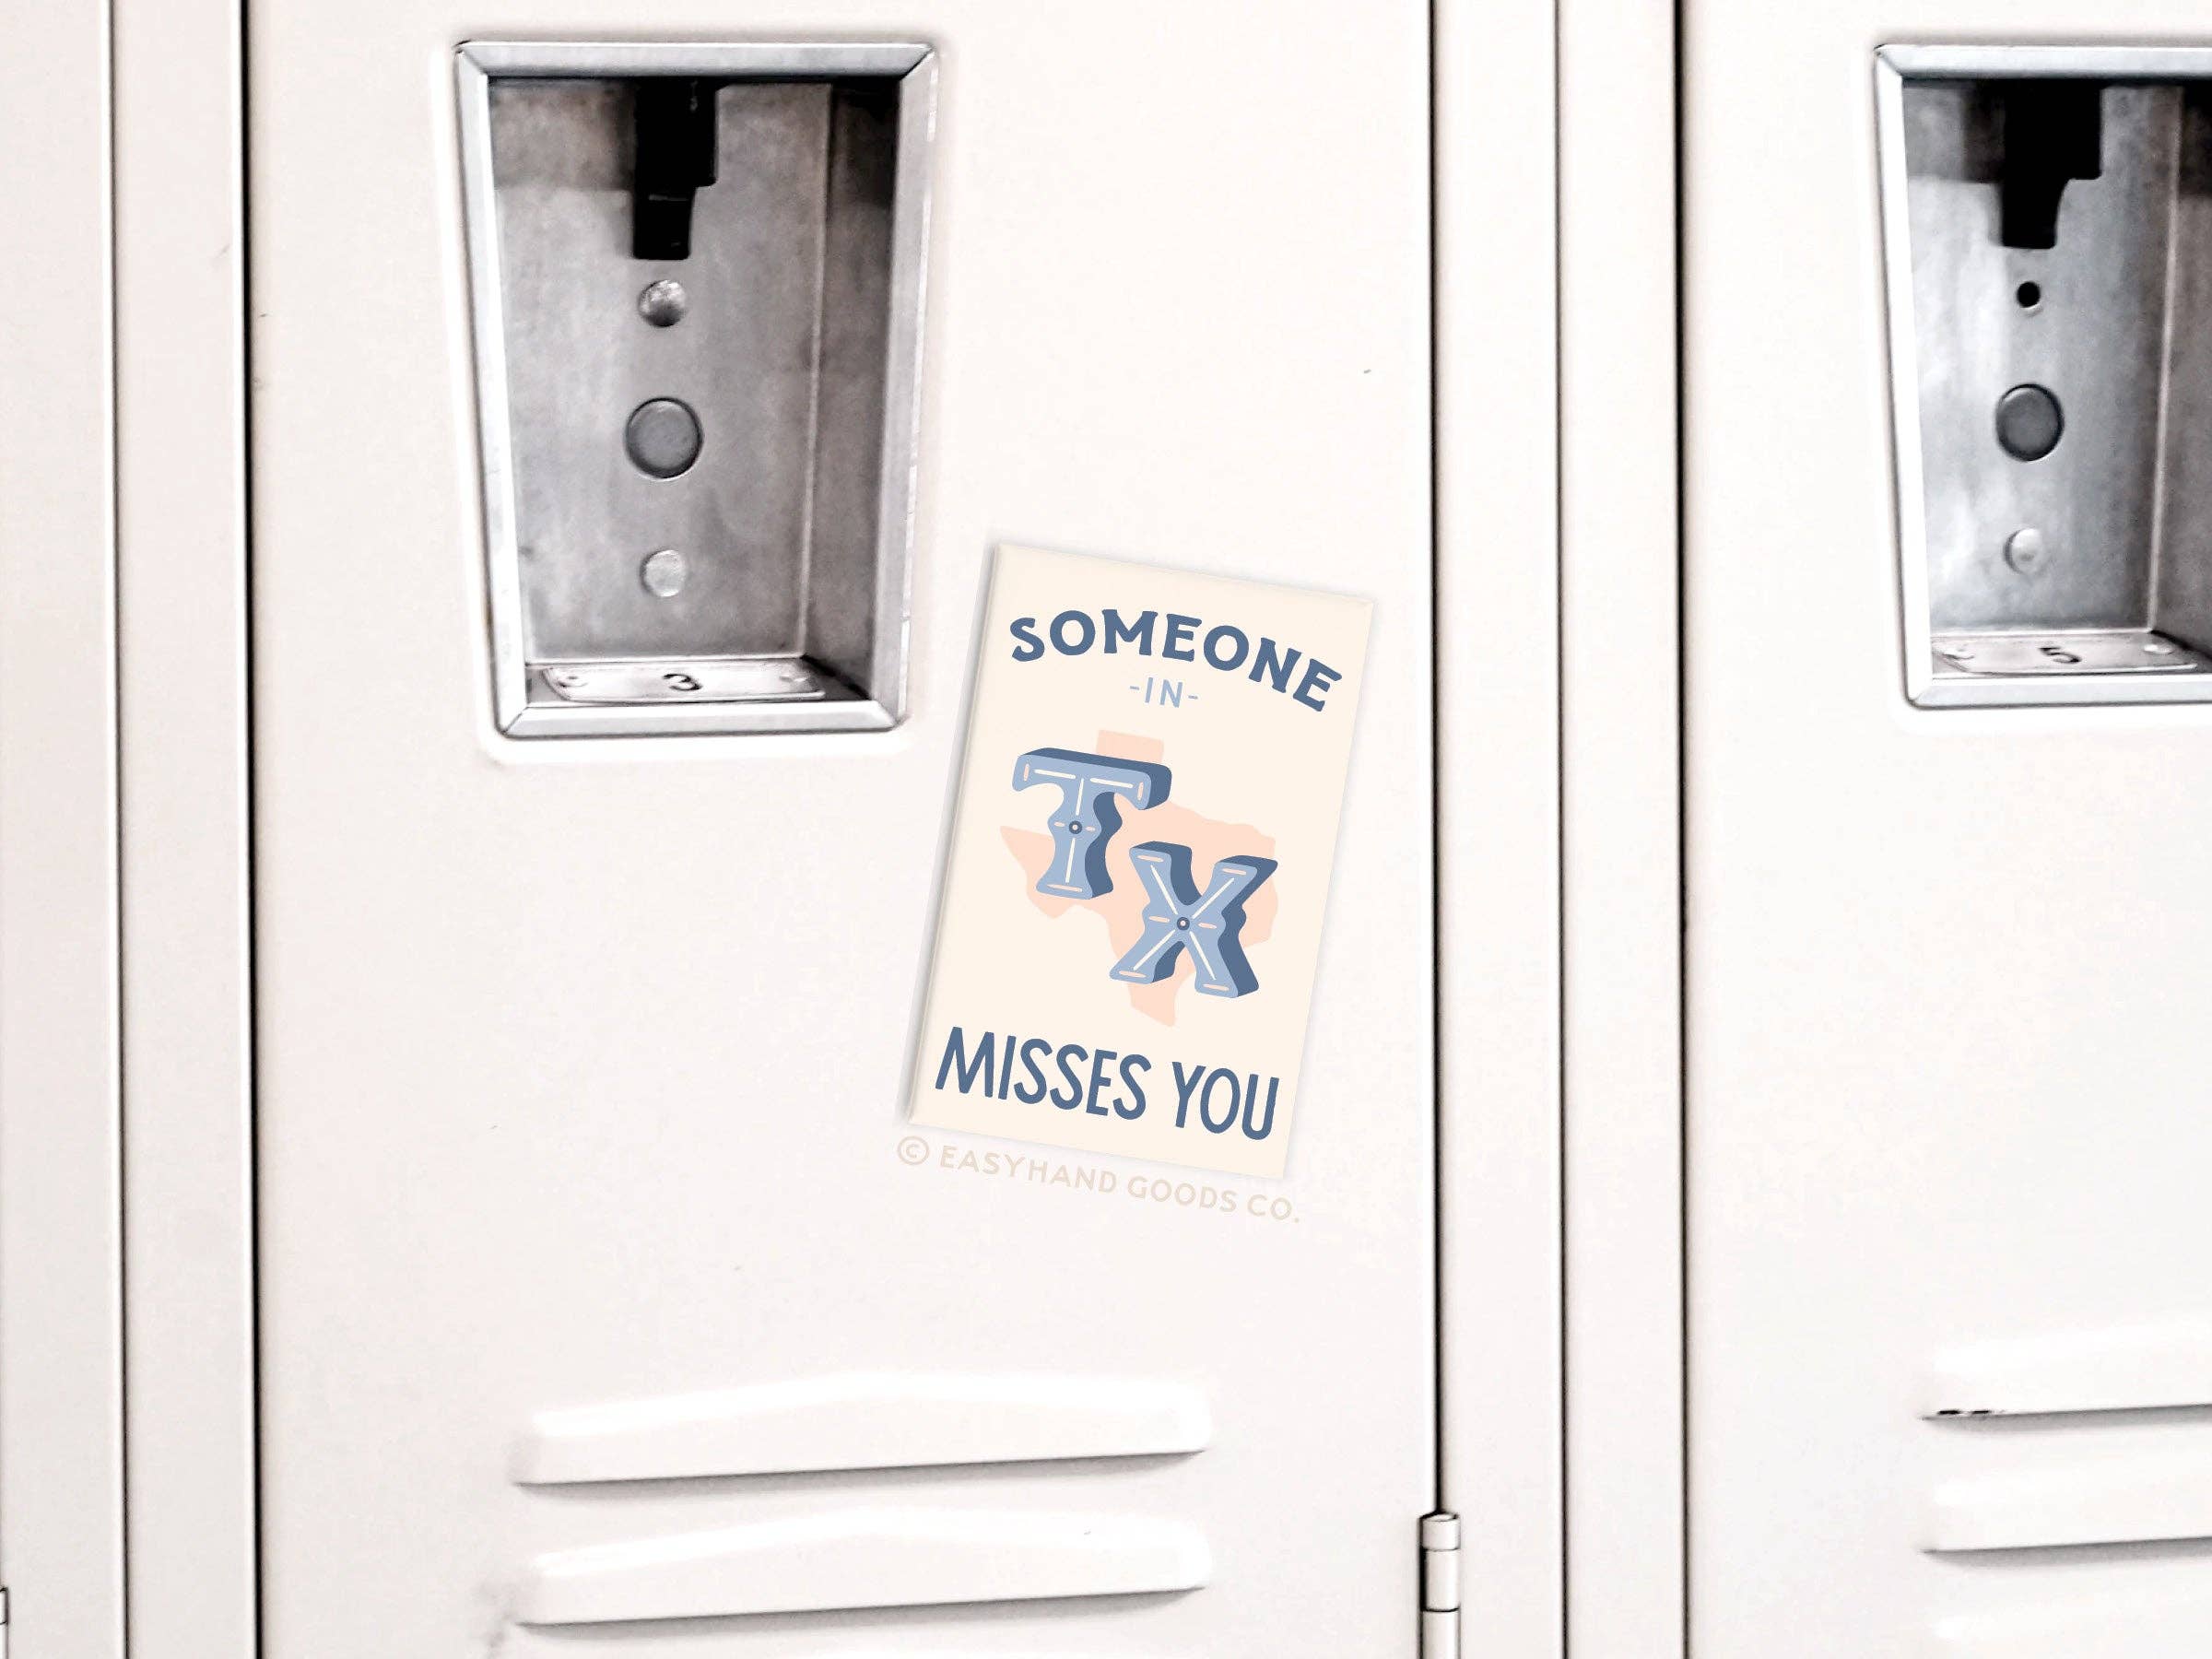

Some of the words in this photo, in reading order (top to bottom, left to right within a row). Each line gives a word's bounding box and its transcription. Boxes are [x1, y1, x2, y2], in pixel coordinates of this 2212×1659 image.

[663, 673, 704, 691] 3
[1010, 609, 1343, 712] SOMEONE
[935, 1027, 1151, 1121] MISSES
[1171, 1061, 1279, 1141] YOU
